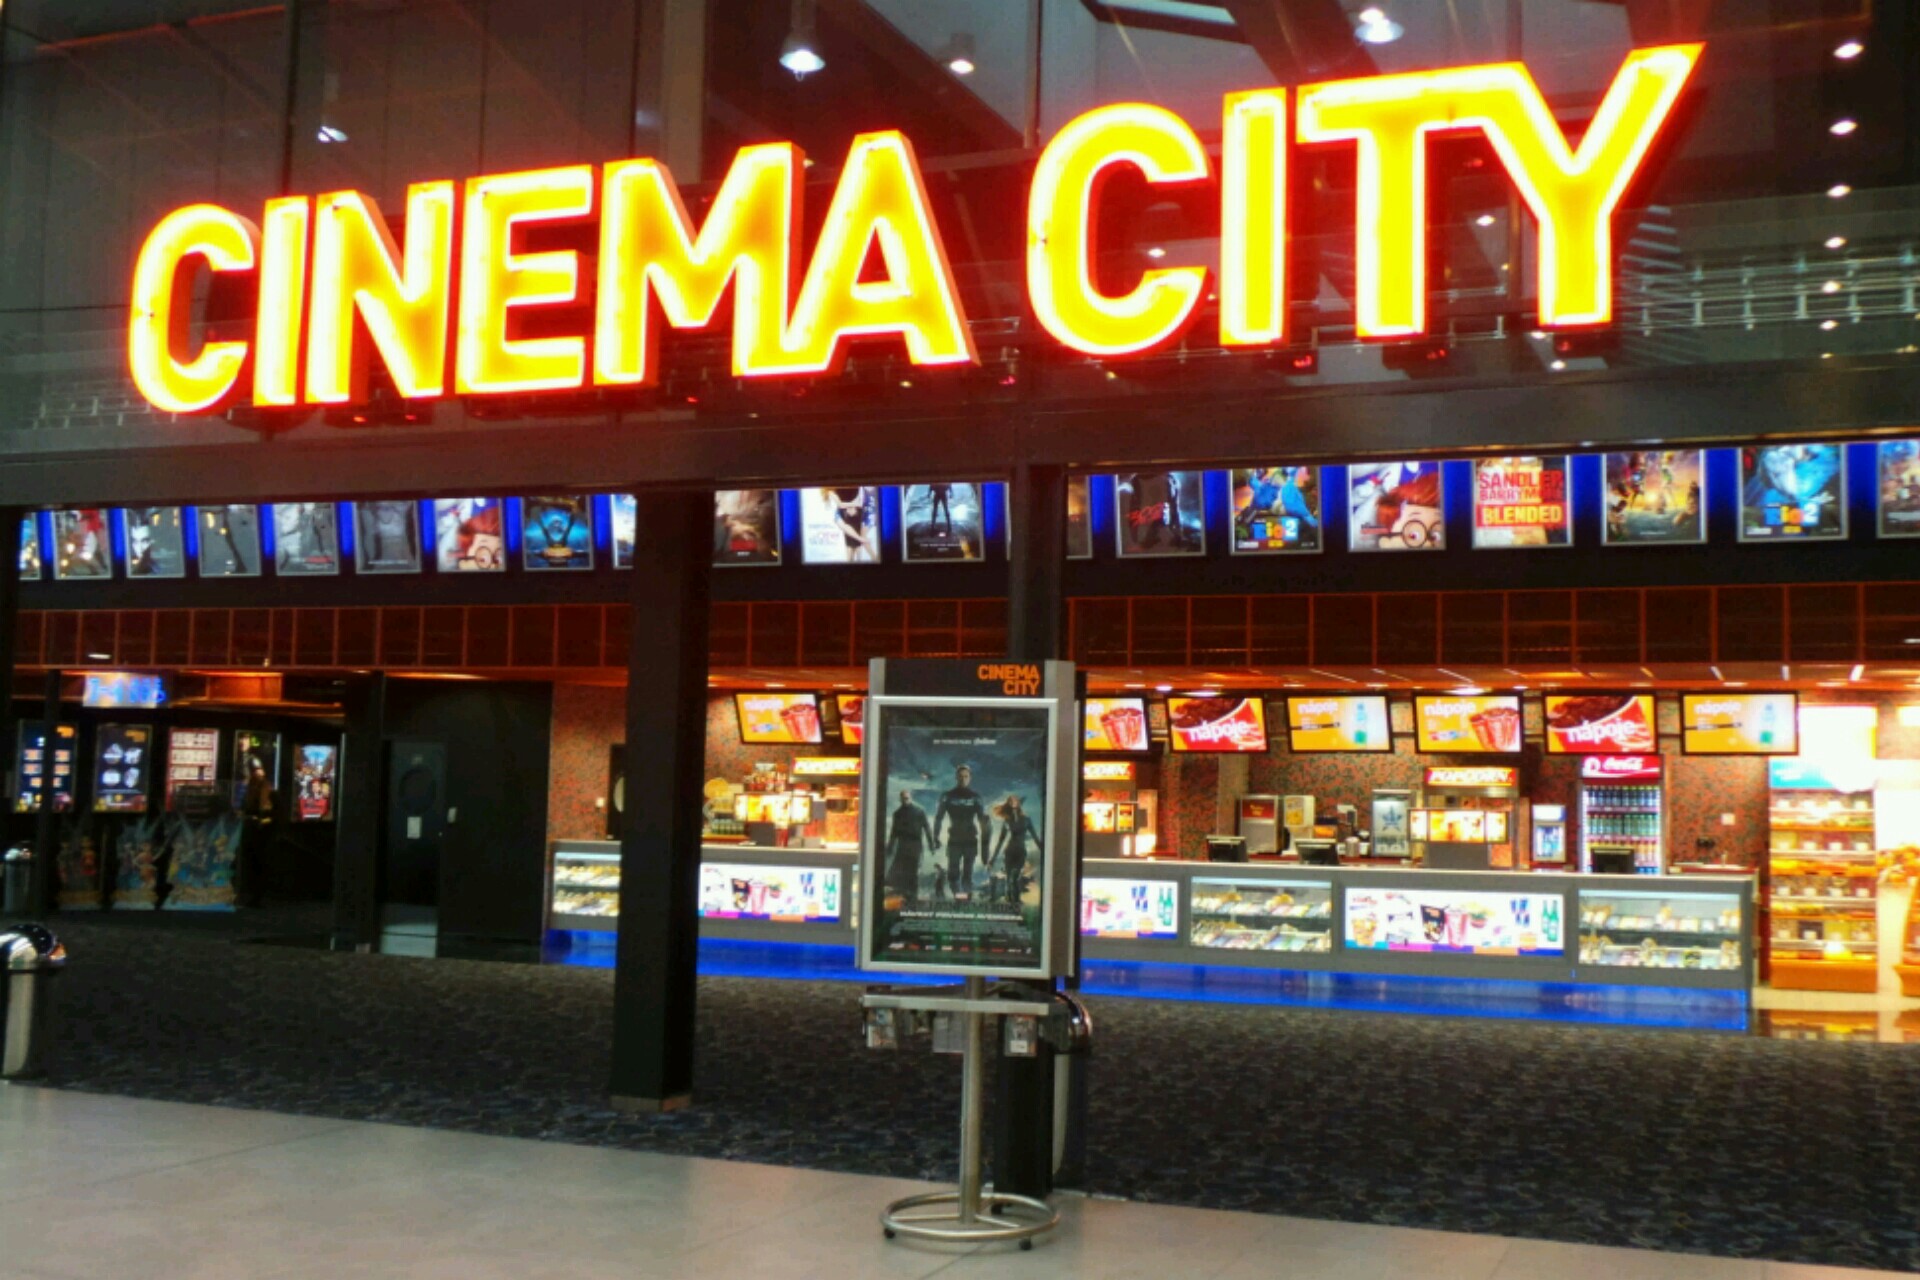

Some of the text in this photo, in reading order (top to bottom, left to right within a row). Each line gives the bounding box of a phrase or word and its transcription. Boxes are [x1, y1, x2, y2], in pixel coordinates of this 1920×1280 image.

[127, 42, 1705, 412] CINEMA CITY
[1479, 470, 1564, 488] SANDLER
[1482, 505, 1562, 524] BLENDED
[978, 664, 1040, 680] CINEMA
[1003, 680, 1039, 695] CITY
[1190, 718, 1249, 742] nápoje
[1568, 719, 1635, 743] nápoje
